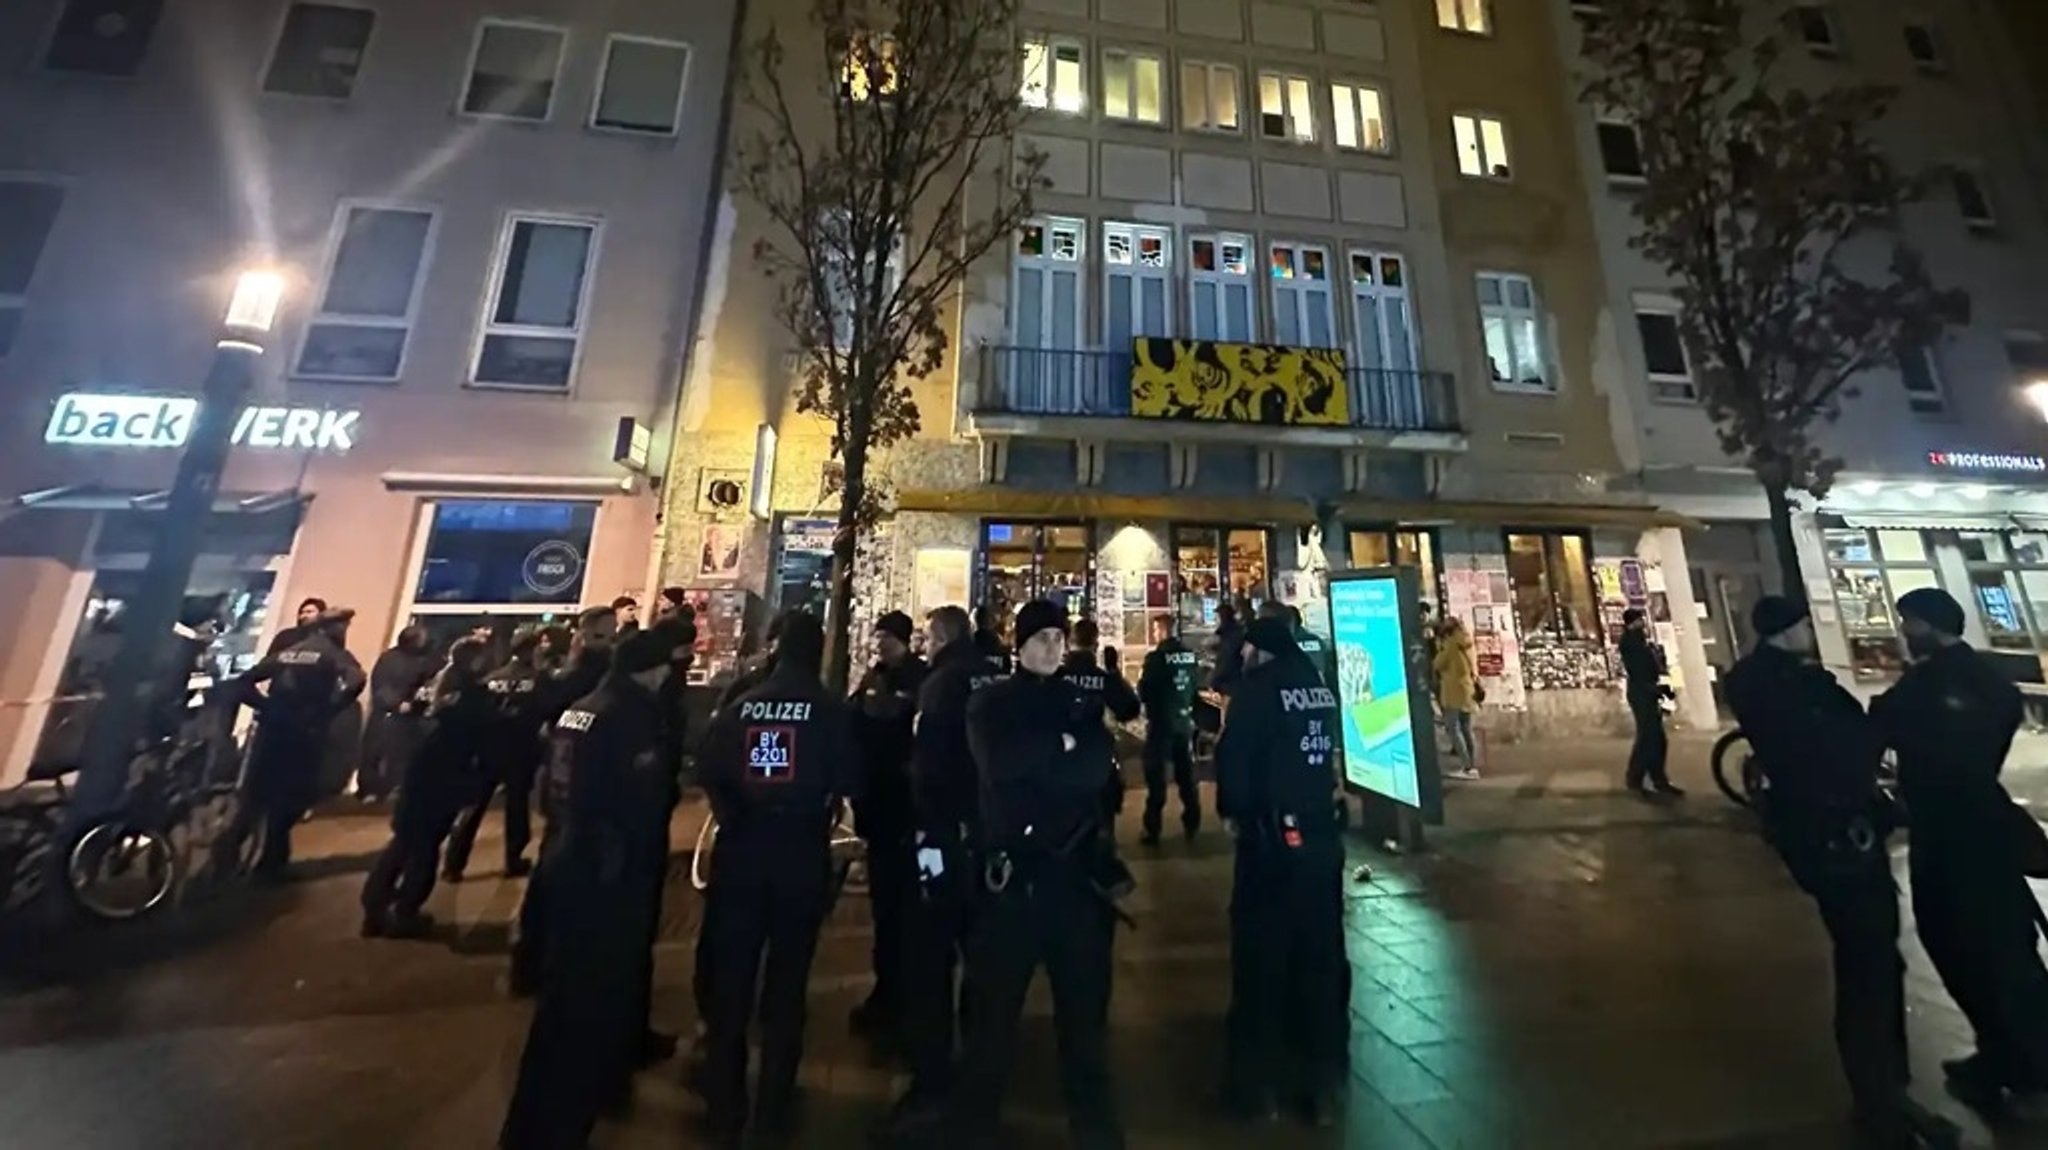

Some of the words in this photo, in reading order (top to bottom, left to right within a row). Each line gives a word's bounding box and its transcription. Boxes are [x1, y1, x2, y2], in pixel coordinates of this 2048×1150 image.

[55, 399, 183, 441] back
[1280, 687, 1337, 712] POLIZEI
[740, 701, 811, 720] POLIZEI
[760, 731, 779, 748] BY
[750, 747, 787, 762] 6201
